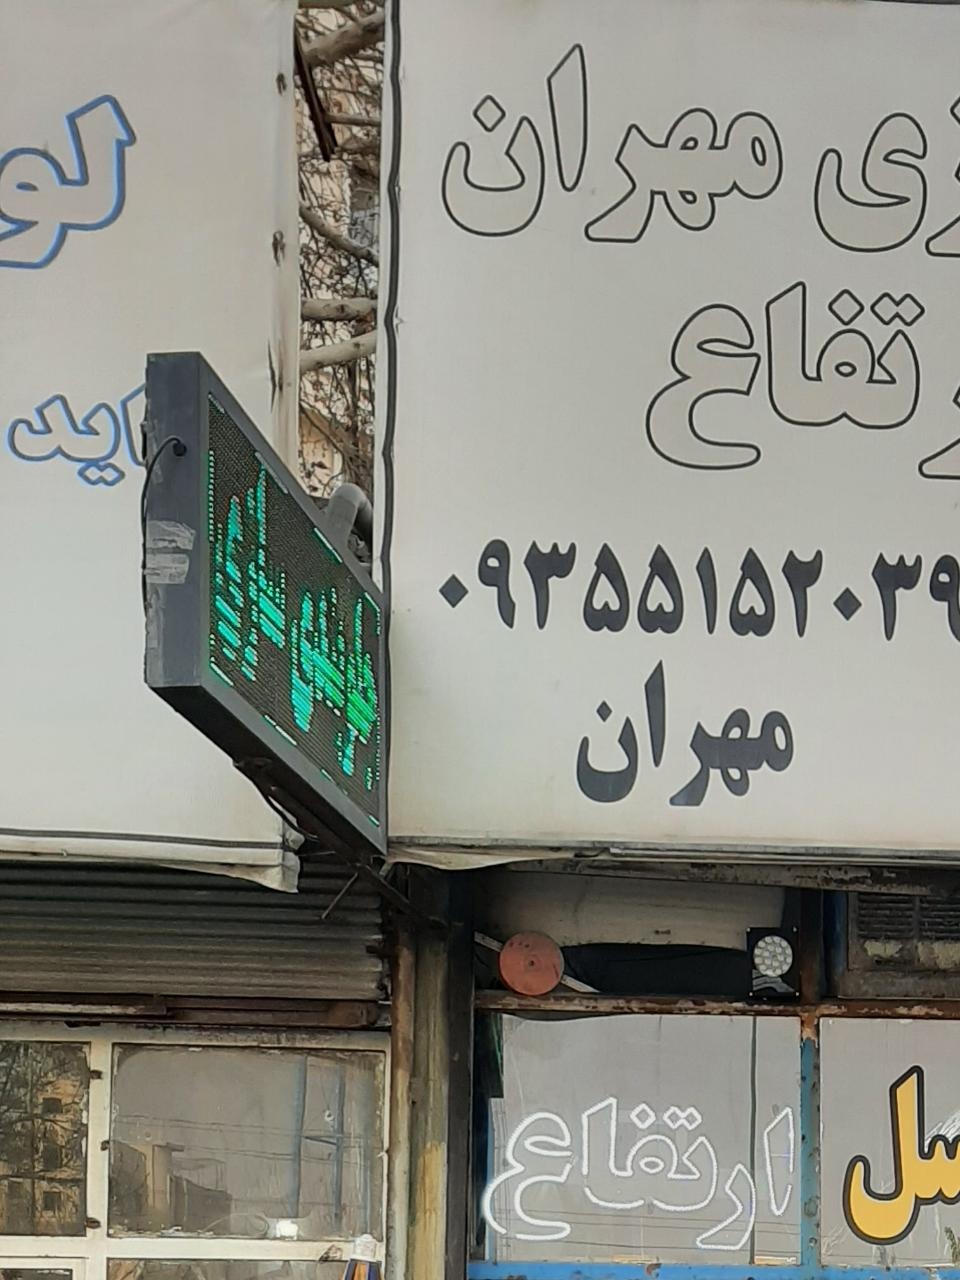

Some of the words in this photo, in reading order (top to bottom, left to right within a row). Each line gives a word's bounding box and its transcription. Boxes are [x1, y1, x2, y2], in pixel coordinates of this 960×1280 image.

[441, 43, 784, 243] مهران
[575, 659, 795, 807] مهران
[482, 1097, 796, 1250] ارتفاع
